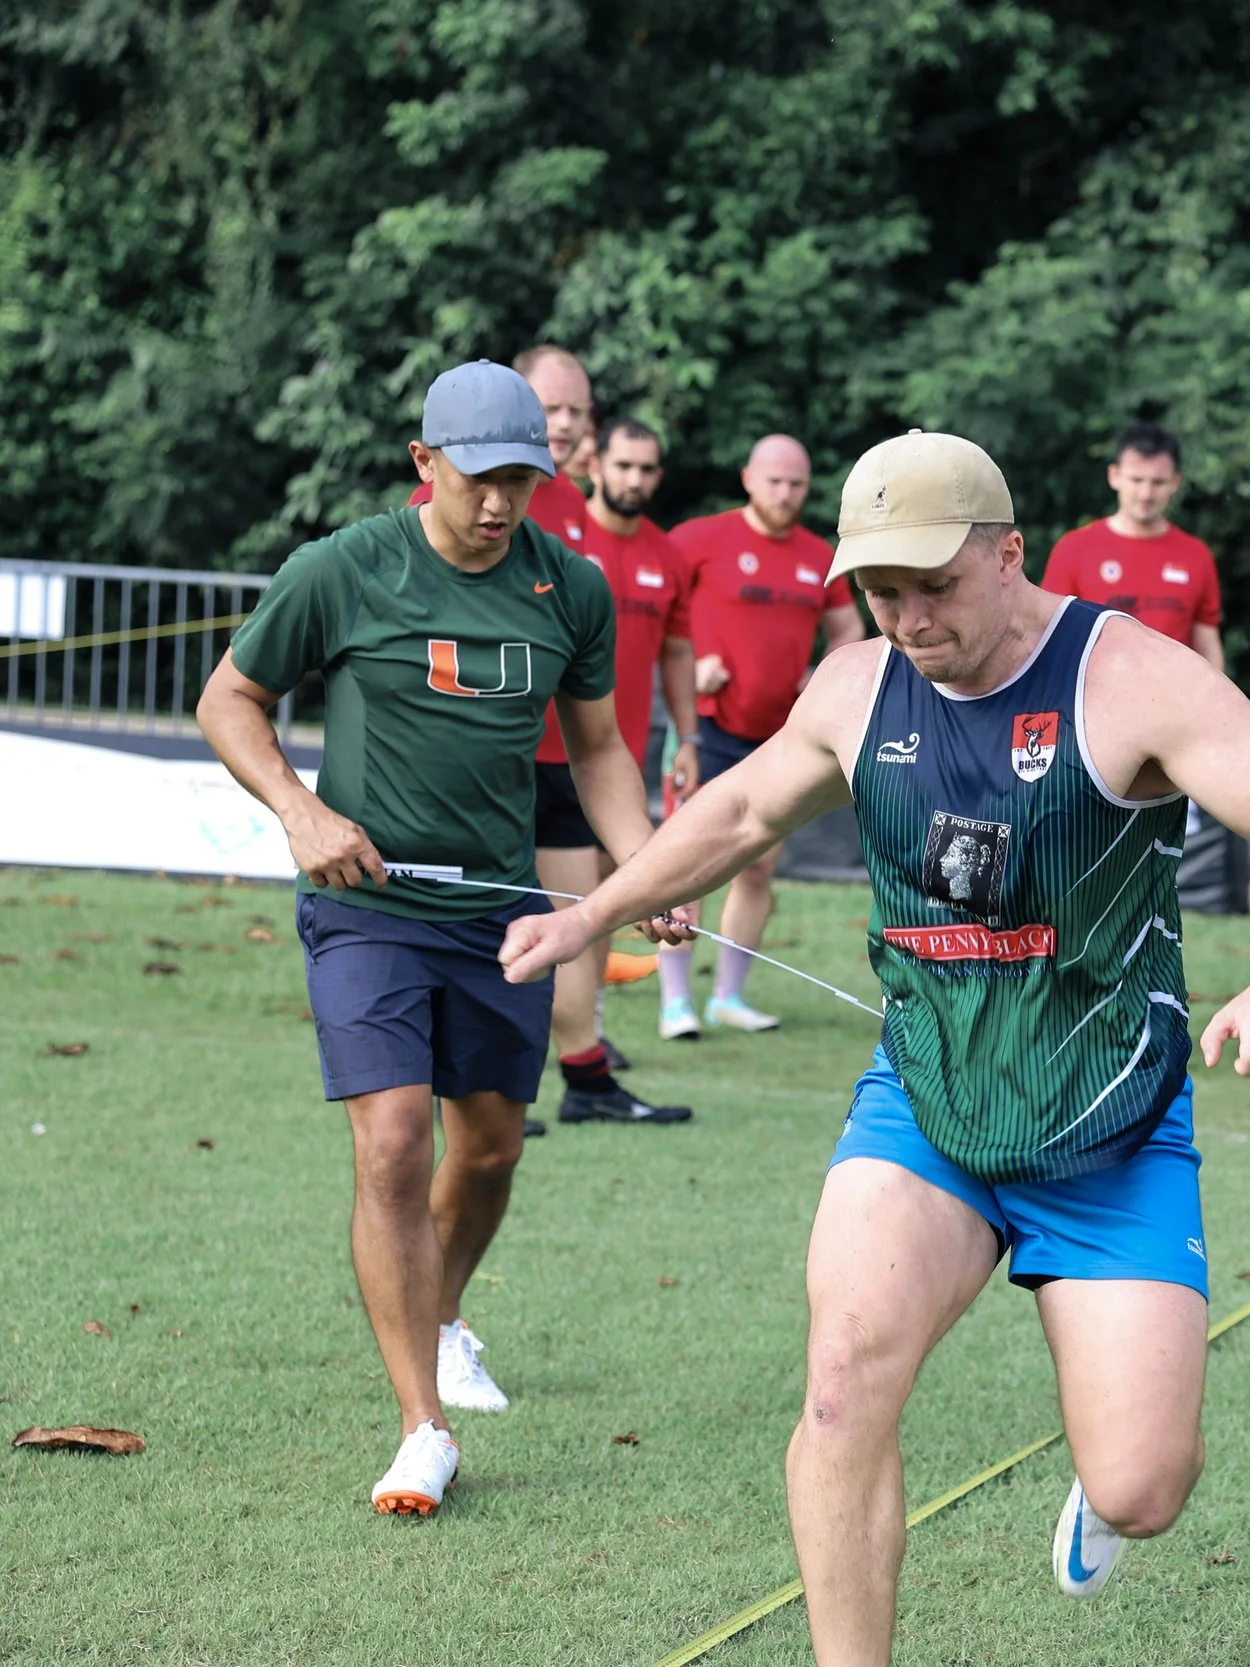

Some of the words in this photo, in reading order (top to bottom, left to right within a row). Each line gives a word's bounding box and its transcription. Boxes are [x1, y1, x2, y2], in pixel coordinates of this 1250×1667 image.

[428, 639, 532, 698] U
[876, 751, 918, 764] tsunami
[1018, 757, 1048, 771] BUCKS
[950, 817, 994, 834] POSTAGE
[887, 935, 925, 954] THE
[929, 931, 991, 954] PENNY
